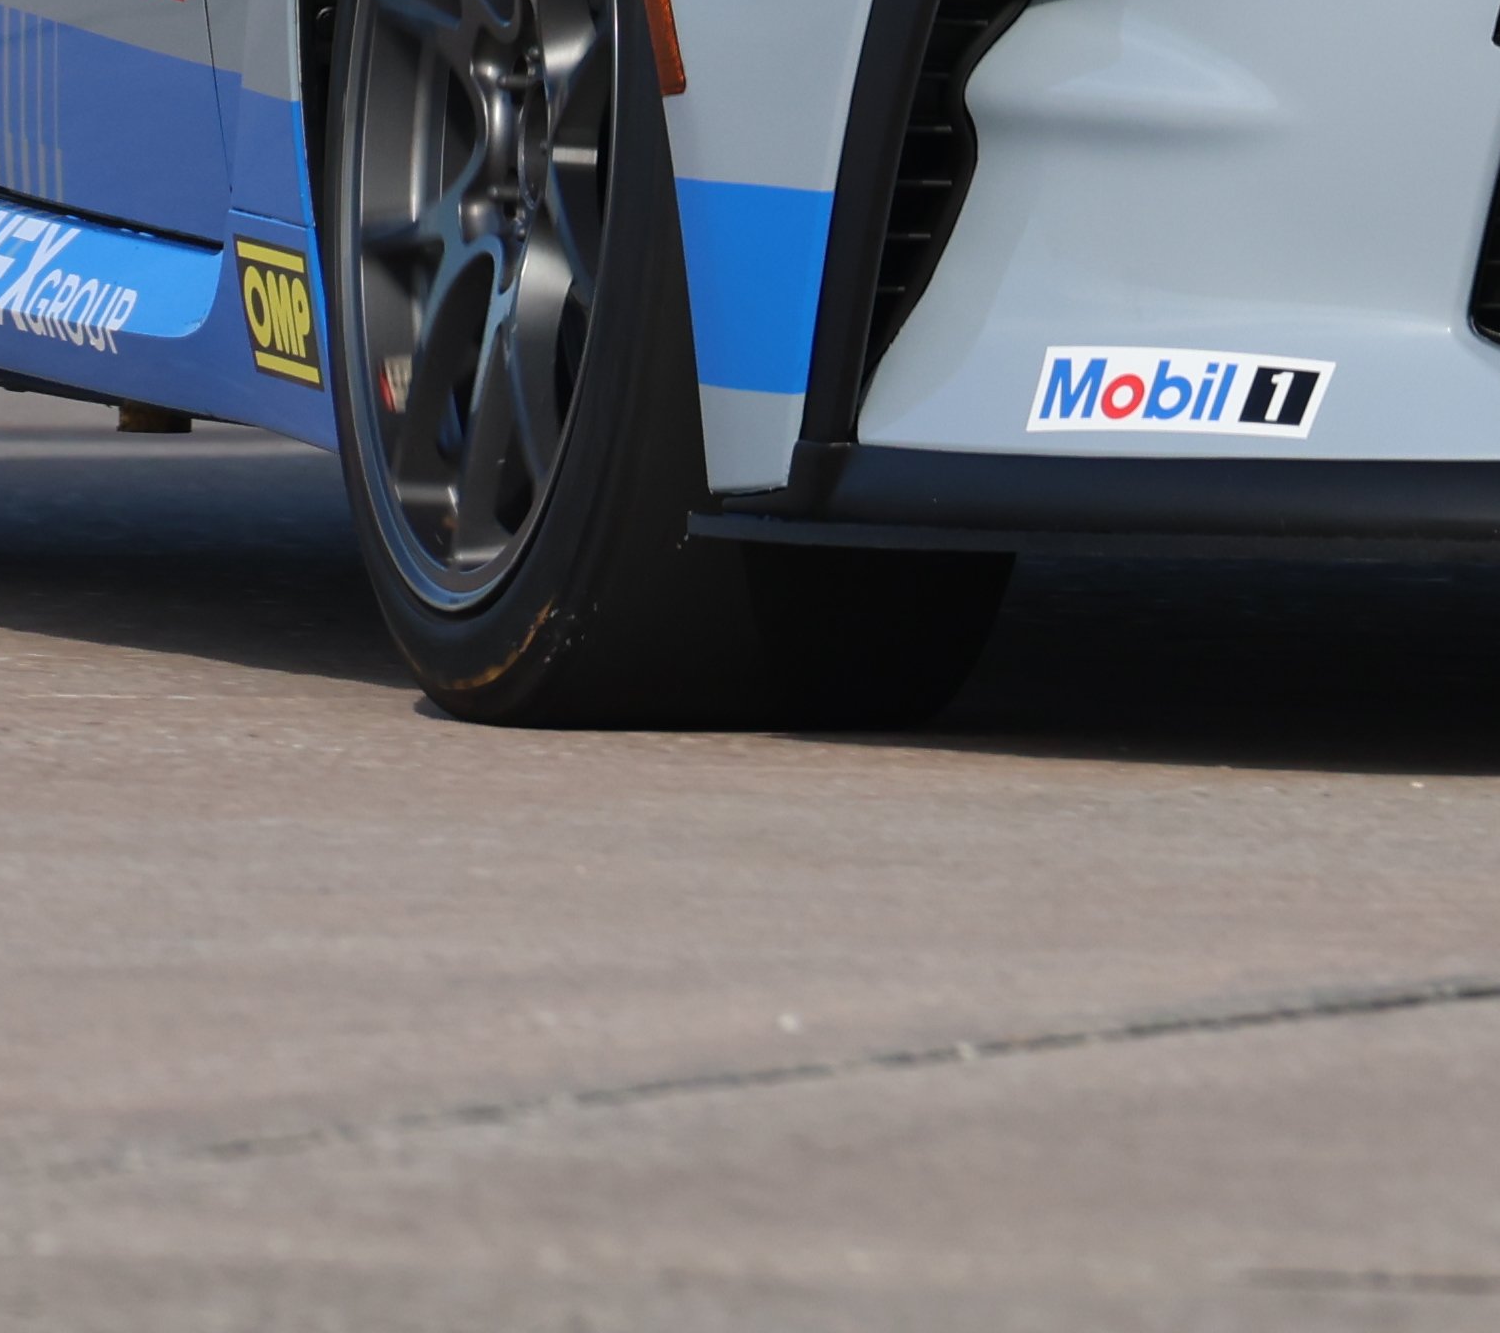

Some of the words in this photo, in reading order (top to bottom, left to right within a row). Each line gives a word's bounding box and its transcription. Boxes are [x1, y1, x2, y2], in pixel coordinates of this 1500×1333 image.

[25, 268, 138, 355] GROUP
[243, 265, 311, 359] OMP
[1038, 357, 1239, 422] Mobil
